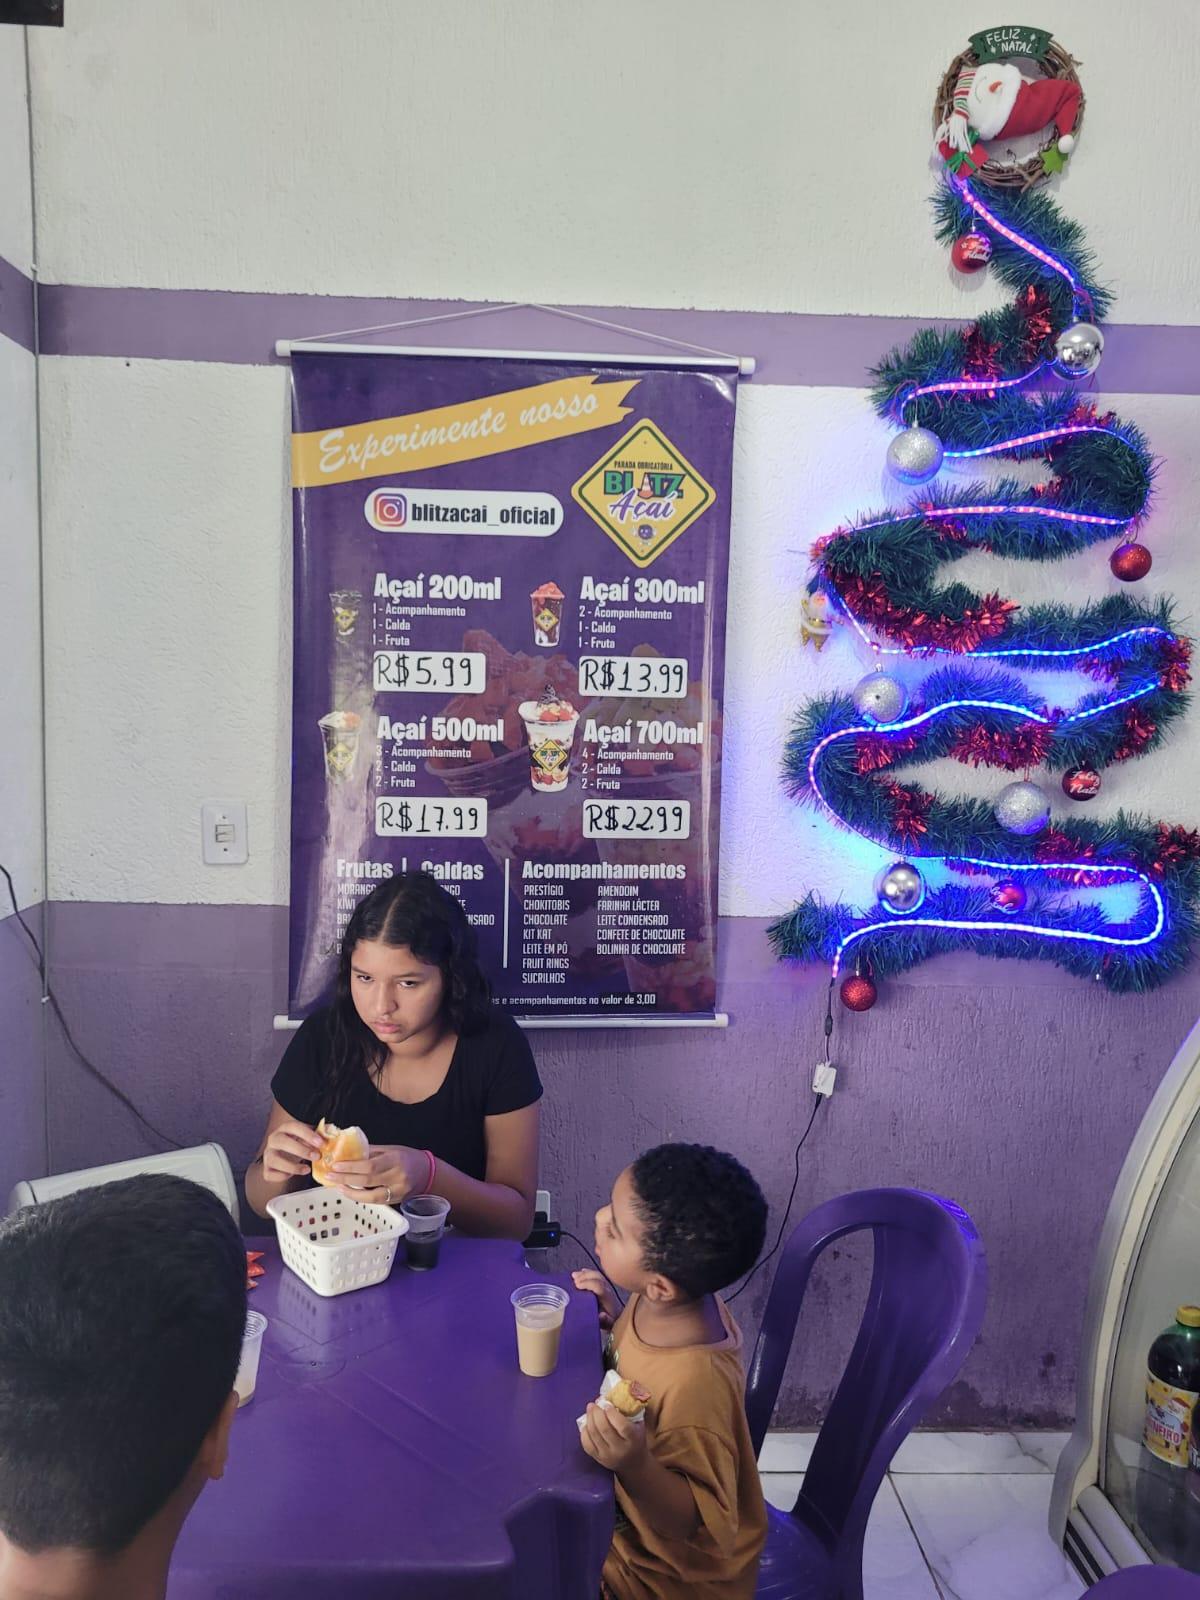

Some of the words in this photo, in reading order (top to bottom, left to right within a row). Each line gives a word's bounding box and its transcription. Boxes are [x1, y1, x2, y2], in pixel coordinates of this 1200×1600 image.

[986, 29, 1020, 45] FELIZ
[1001, 41, 1032, 54] NATAL
[319, 407, 507, 473] Experimente
[519, 392, 599, 426] nosso
[614, 461, 636, 469] PARADA
[609, 488, 674, 521] Açaí
[411, 503, 555, 527] blitzacai_oficial
[374, 572, 424, 604] Açaí
[428, 574, 501, 600] 200ml
[580, 576, 630, 607] Açaí
[634, 578, 704, 604] 300ml
[385, 603, 466, 617] Acompanhamento
[579, 606, 585, 617] 2
[594, 607, 672, 620] Acompanhamento
[385, 618, 411, 630] Calda
[591, 621, 616, 633] Calda
[385, 634, 410, 646] Fruta
[591, 637, 615, 648] Fruta
[377, 715, 427, 746] Açaí
[432, 717, 504, 742] 500ml
[583, 719, 632, 748] Açaí
[637, 720, 703, 744] 700ml
[376, 745, 382, 757] 3
[391, 746, 471, 759] Acompanhamento
[582, 748, 588, 759] 4
[597, 749, 674, 761] Acompanhamento
[376, 760, 382, 772] 2
[391, 761, 416, 772] Calda
[582, 763, 588, 774] 2
[597, 763, 621, 774] Calda
[376, 776, 381, 787] 2
[391, 776, 415, 787] Fruta
[582, 778, 587, 789] 2
[597, 778, 620, 789] Fruta
[337, 859, 393, 878] Frutas
[522, 861, 686, 880] Acompanhamentos
[524, 883, 563, 896] PRESTÍGIO
[598, 886, 639, 897] AMENDOIM
[524, 900, 570, 911] CHOKITOBIS
[598, 900, 630, 911] FARINHA
[632, 898, 660, 911] LÁCTEA
[524, 914, 568, 926] CHOCOLATE
[598, 914, 616, 926] LEITE
[618, 915, 668, 926] CONDENSADO
[523, 929, 535, 940] KIT
[537, 929, 552, 940] KAT
[597, 929, 629, 940] CONFETE
[631, 929, 641, 940] DE
[642, 929, 686, 940] CHOCOLATE
[523, 943, 541, 955] LEITE
[544, 943, 555, 955] EM
[557, 941, 568, 955] PÓ
[597, 943, 629, 955] BOLINHA
[631, 944, 641, 955] DE
[643, 943, 686, 955] CHOCOLATE
[523, 958, 544, 969] FRUIT
[546, 958, 569, 969] RINGS
[522, 972, 566, 984] SUCRILHOS
[509, 995, 586, 1007] acompanhamentos
[589, 997, 599, 1005] no
[602, 994, 622, 1005] valor
[625, 994, 634, 1005] de
[637, 994, 656, 1006] 3,00
